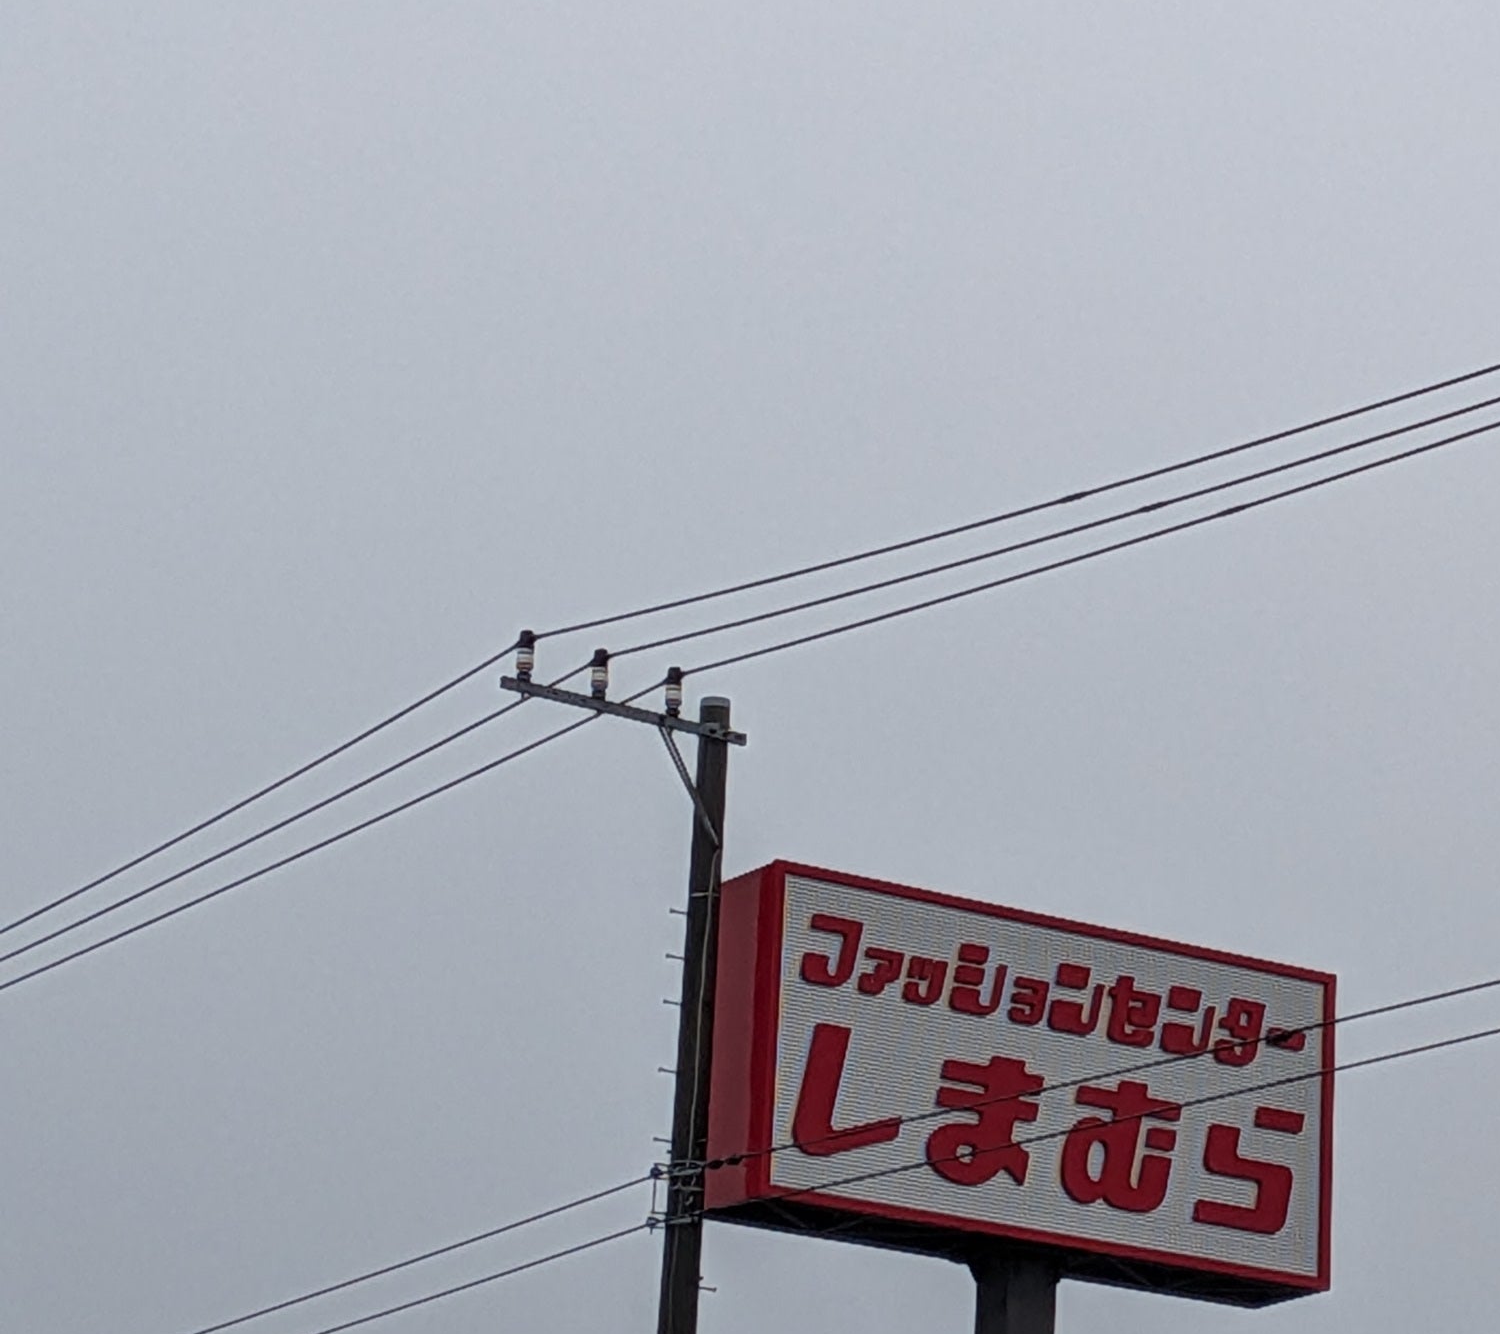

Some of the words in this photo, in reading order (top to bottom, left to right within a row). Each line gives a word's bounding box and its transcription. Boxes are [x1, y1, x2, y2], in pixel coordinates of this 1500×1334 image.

[800, 913, 1305, 1067] ファッションセンター
[792, 1023, 1305, 1235] しまむら
